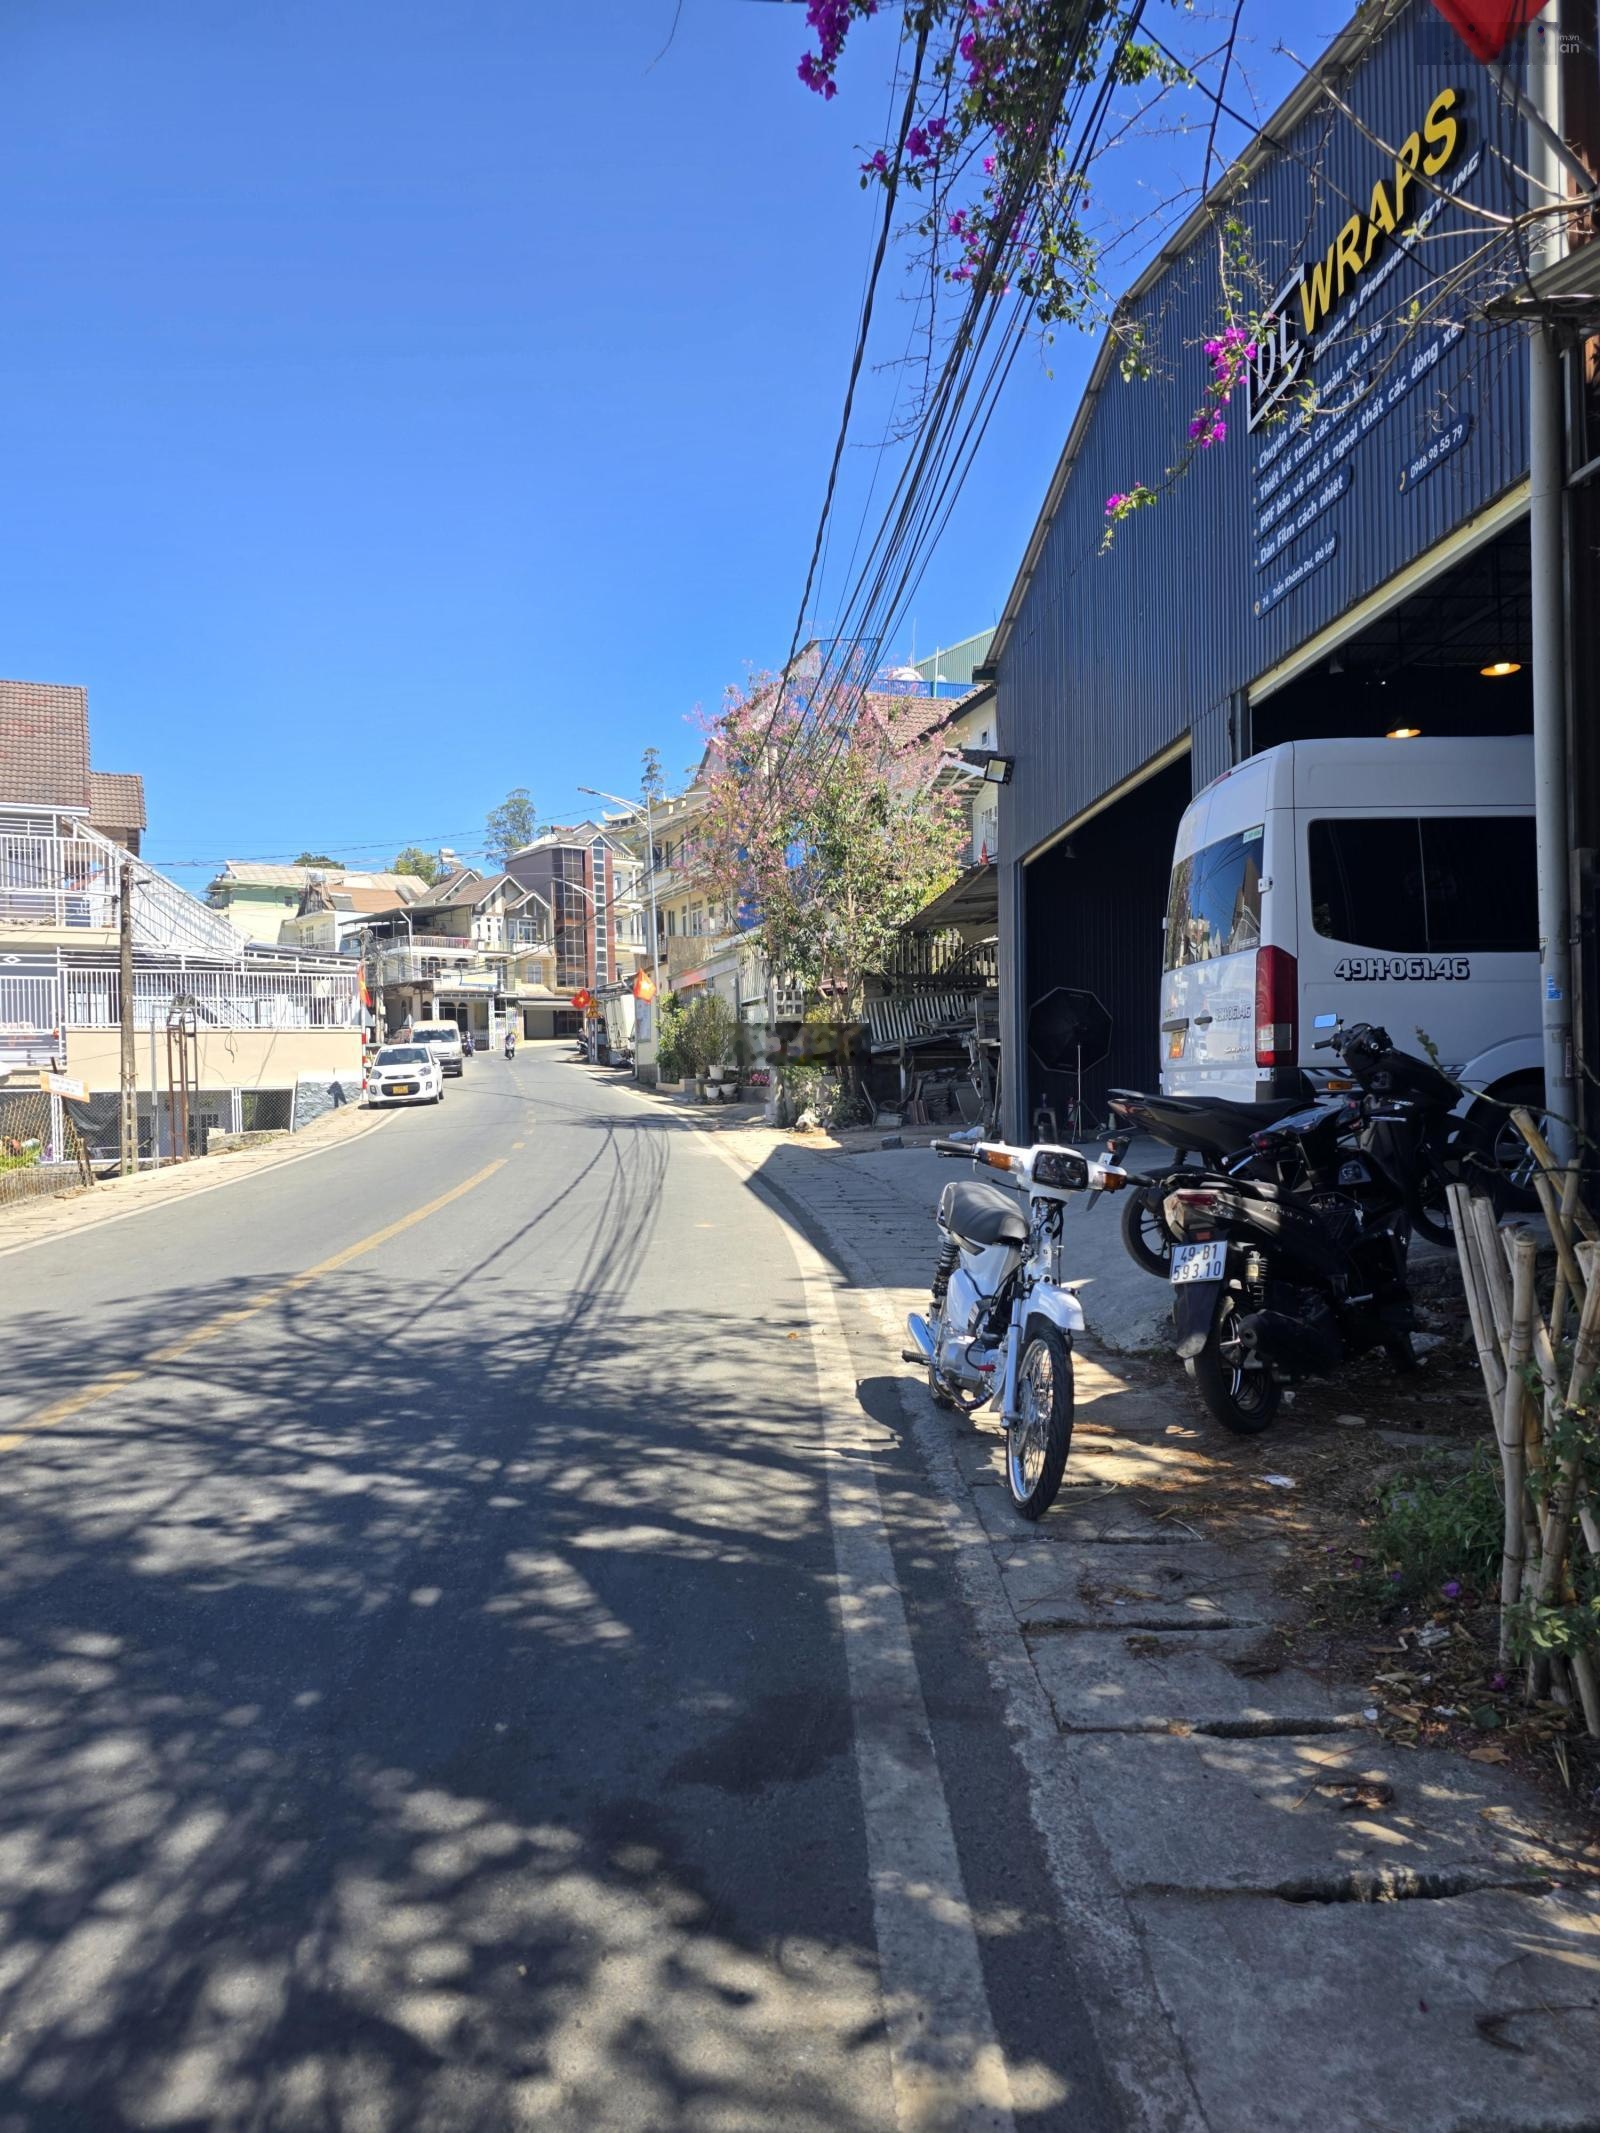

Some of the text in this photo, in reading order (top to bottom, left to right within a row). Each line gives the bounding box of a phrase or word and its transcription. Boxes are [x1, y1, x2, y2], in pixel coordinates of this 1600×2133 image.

[1300, 88, 1457, 336] WRAPS
[1259, 430, 1287, 469] Chuyên
[1322, 366, 1343, 398] màu
[1346, 350, 1359, 372] xe
[1260, 505, 1275, 532] PPF
[1322, 452, 1331, 470] &
[1332, 422, 1358, 460] ngoại
[1361, 397, 1384, 430] thất
[1388, 375, 1407, 403] các
[1411, 340, 1439, 380] dòng
[1443, 322, 1459, 348] xe
[1294, 437, 1313, 462] tem
[1314, 418, 1330, 442] các
[1428, 444, 1438, 463] 98
[1440, 436, 1450, 453] 55
[1452, 424, 1463, 443] 79
[1260, 474, 1343, 564] Dán Film cách nhiệt
[1173, 1261, 1222, 1281] 593.10
